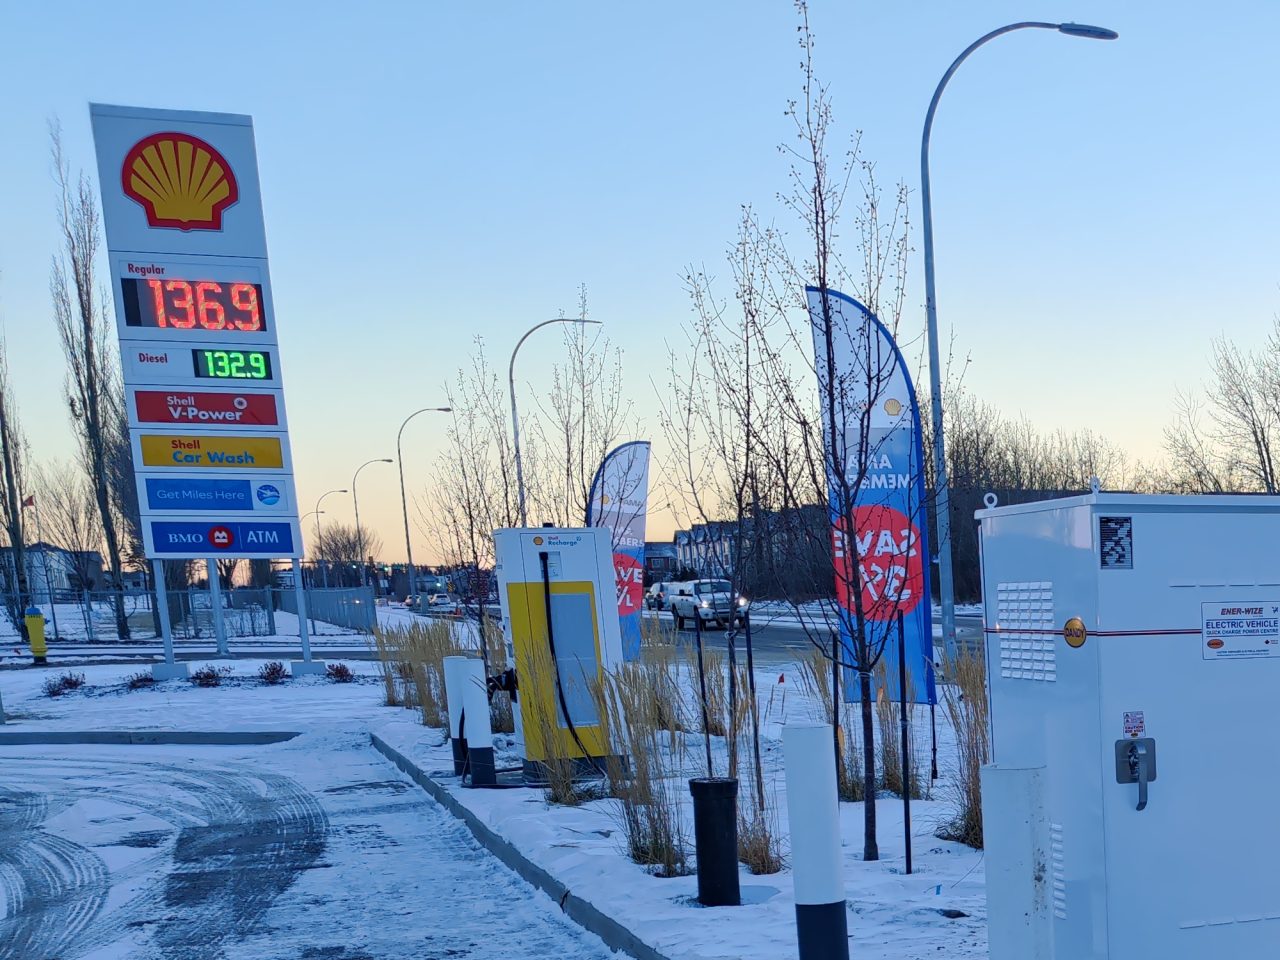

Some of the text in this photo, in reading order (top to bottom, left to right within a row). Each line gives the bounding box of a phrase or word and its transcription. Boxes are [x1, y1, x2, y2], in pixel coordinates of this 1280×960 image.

[127, 263, 166, 276] Regular
[148, 279, 261, 331] 136.9
[138, 352, 168, 364] Diesel
[204, 351, 266, 378] 132.9
[167, 396, 195, 406] Shell
[168, 406, 243, 421] V-Power
[171, 440, 201, 450] Shell
[172, 451, 255, 465] Car Wash
[156, 489, 245, 501] Get Miles Here
[168, 531, 279, 544] BMO ATM
[1220, 607, 1264, 616] ENER-WIZE
[1206, 620, 1279, 629] ELECTRIC VEHICLE
